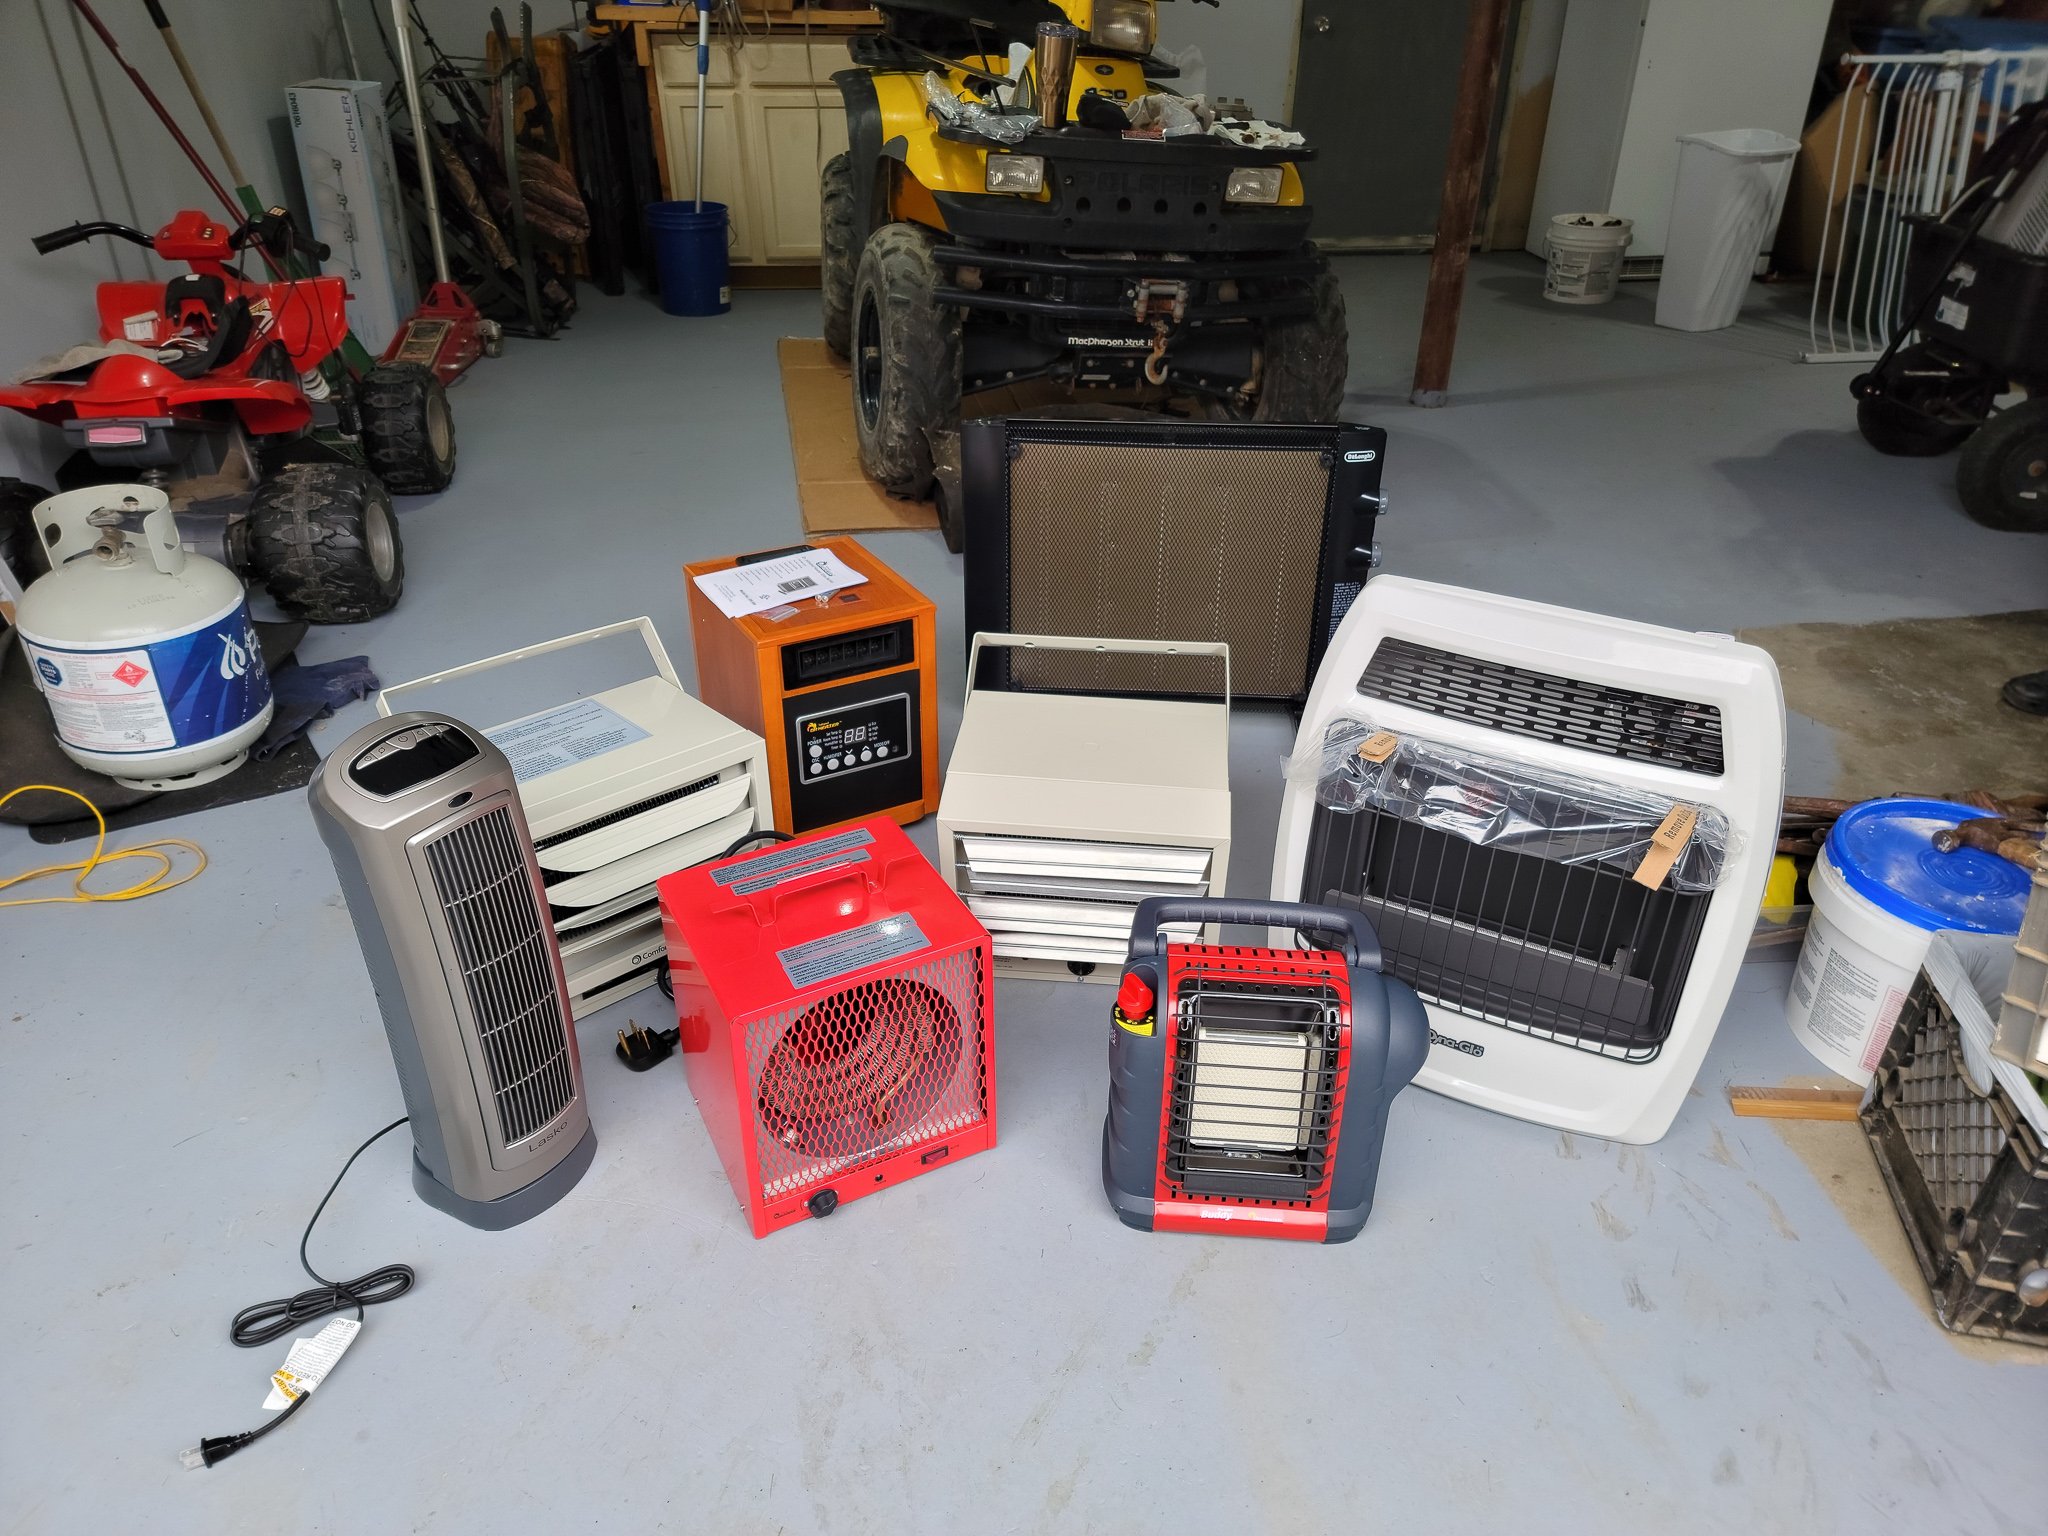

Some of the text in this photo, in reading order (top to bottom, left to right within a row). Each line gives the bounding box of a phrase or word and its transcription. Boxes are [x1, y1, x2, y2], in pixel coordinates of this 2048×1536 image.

[341, 95, 359, 153] KICHLER
[1067, 337, 1124, 347] MacPherson
[1124, 338, 1145, 347] Strut
[807, 738, 822, 746] POWER
[1664, 818, 1685, 840] Remove
[528, 1121, 568, 1153] Lasko
[1200, 1209, 1233, 1221] Buddy
[331, 1319, 345, 1327] NOT
[283, 1364, 312, 1380] REDUCE
